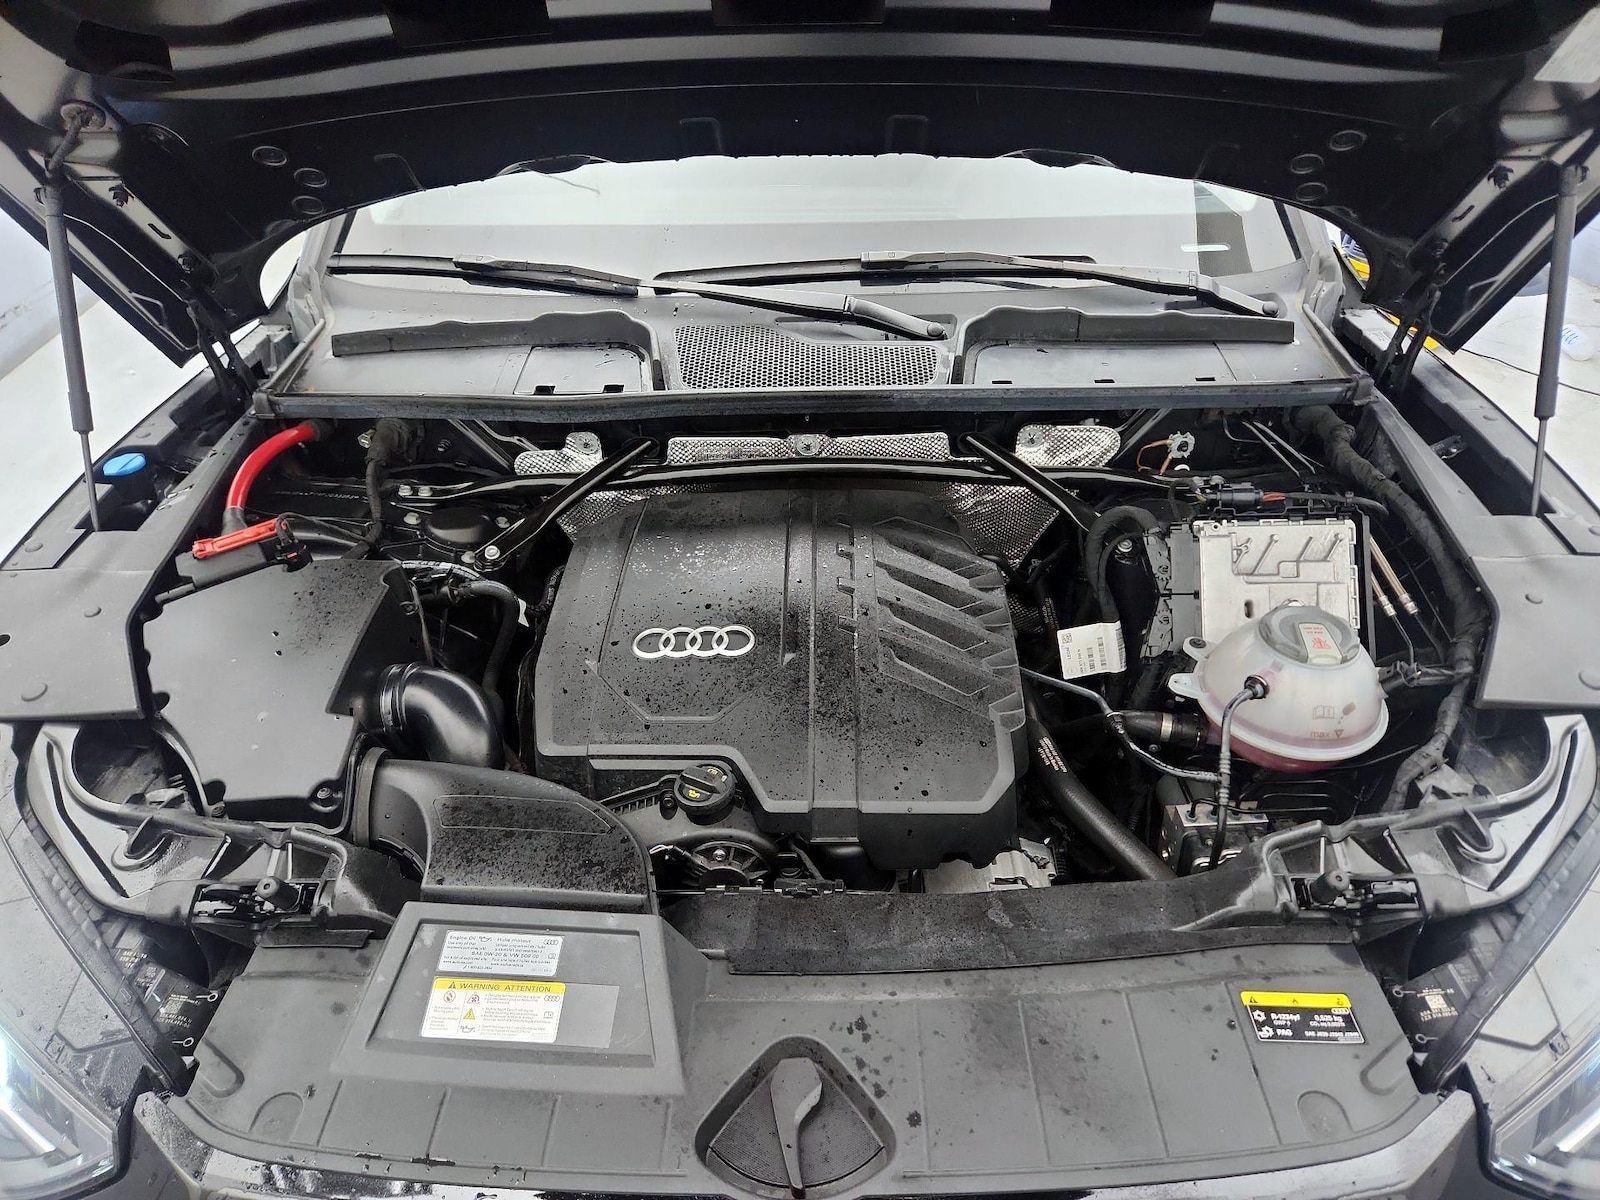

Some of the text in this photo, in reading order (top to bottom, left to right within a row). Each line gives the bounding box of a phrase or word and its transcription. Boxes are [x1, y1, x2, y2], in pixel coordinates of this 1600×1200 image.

[459, 982, 551, 992] WARNING ATTENTION
[1270, 1013, 1301, 1022] R-1234yf
[1276, 1028, 1293, 1036] PAG
